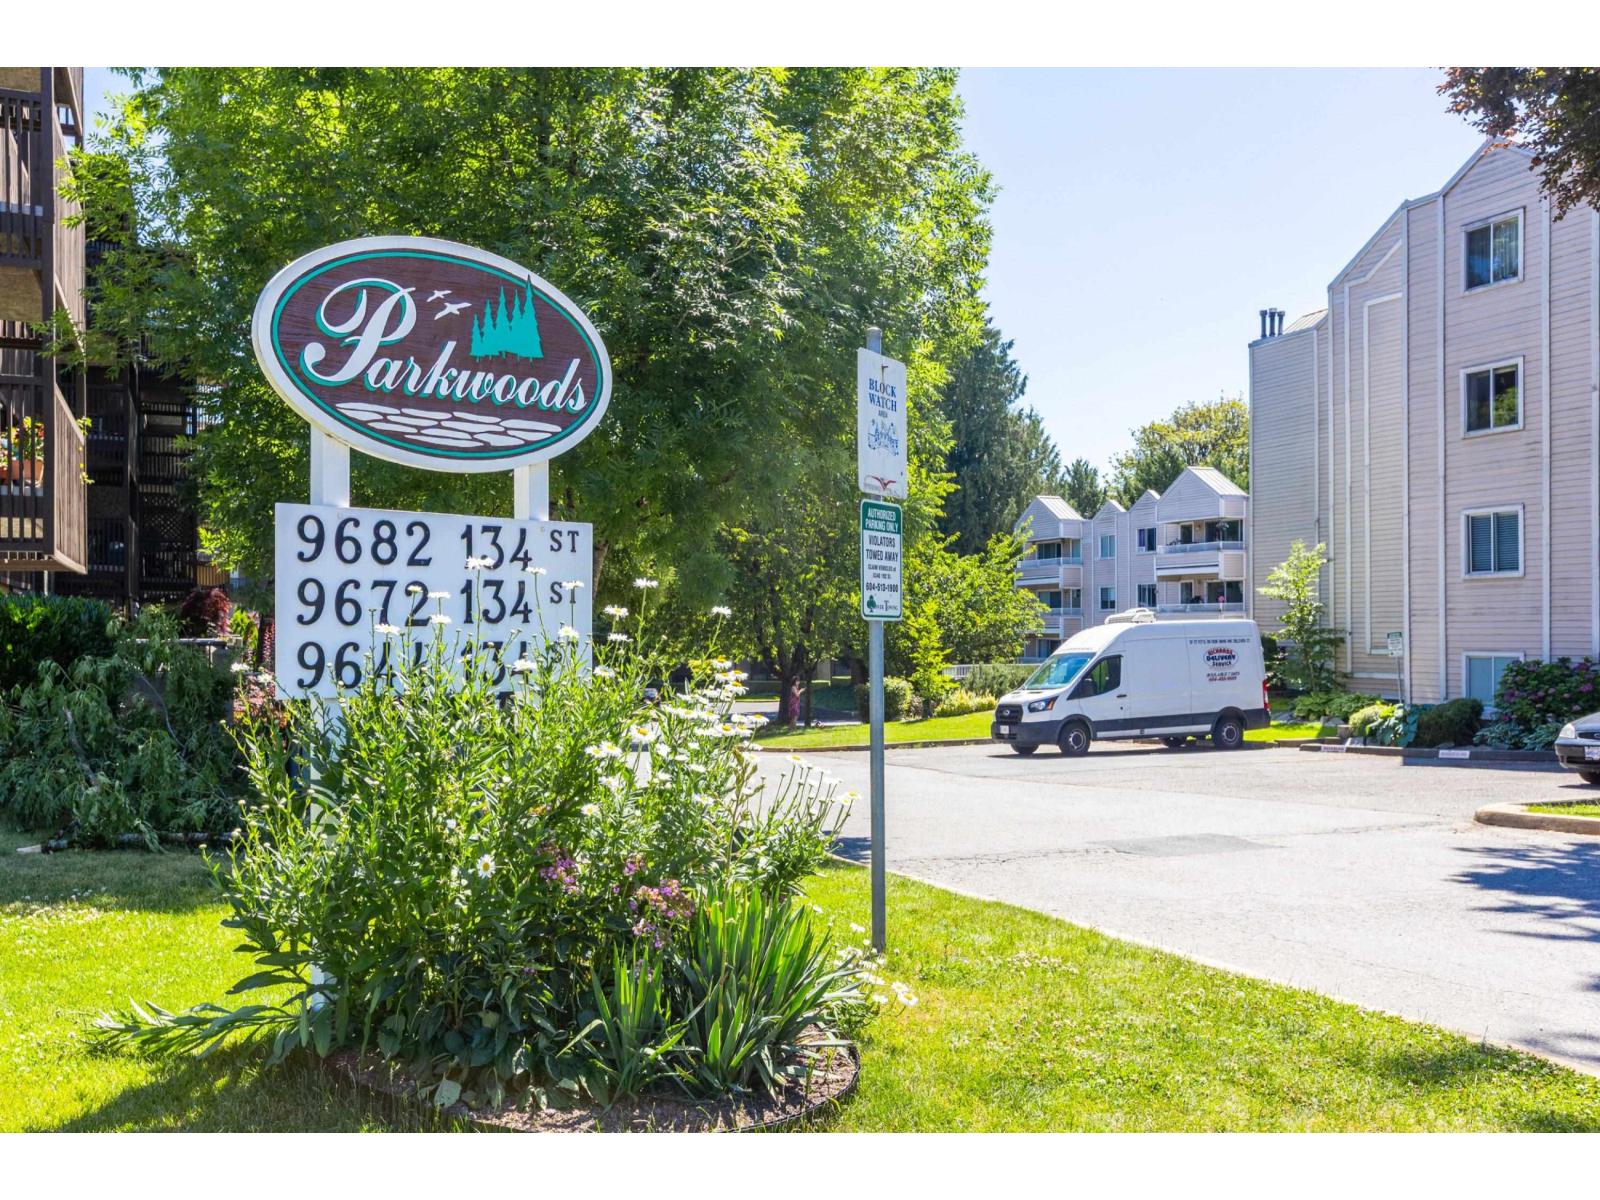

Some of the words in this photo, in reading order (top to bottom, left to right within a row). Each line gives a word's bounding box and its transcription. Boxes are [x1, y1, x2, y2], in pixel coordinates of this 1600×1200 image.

[300, 277, 588, 413] Parkwoods
[868, 378, 896, 398] BLOCK
[868, 392, 897, 412] WATCH
[865, 519, 886, 531] PARKING
[886, 522, 898, 532] ONLY
[297, 514, 432, 567] 9682
[460, 524, 533, 572] 134
[549, 529, 579, 553] ST
[868, 535, 896, 548] VIOLATORS
[866, 549, 884, 561] TOWED
[885, 552, 898, 562] AWAY
[296, 577, 432, 627] 9672
[460, 578, 533, 625] 134
